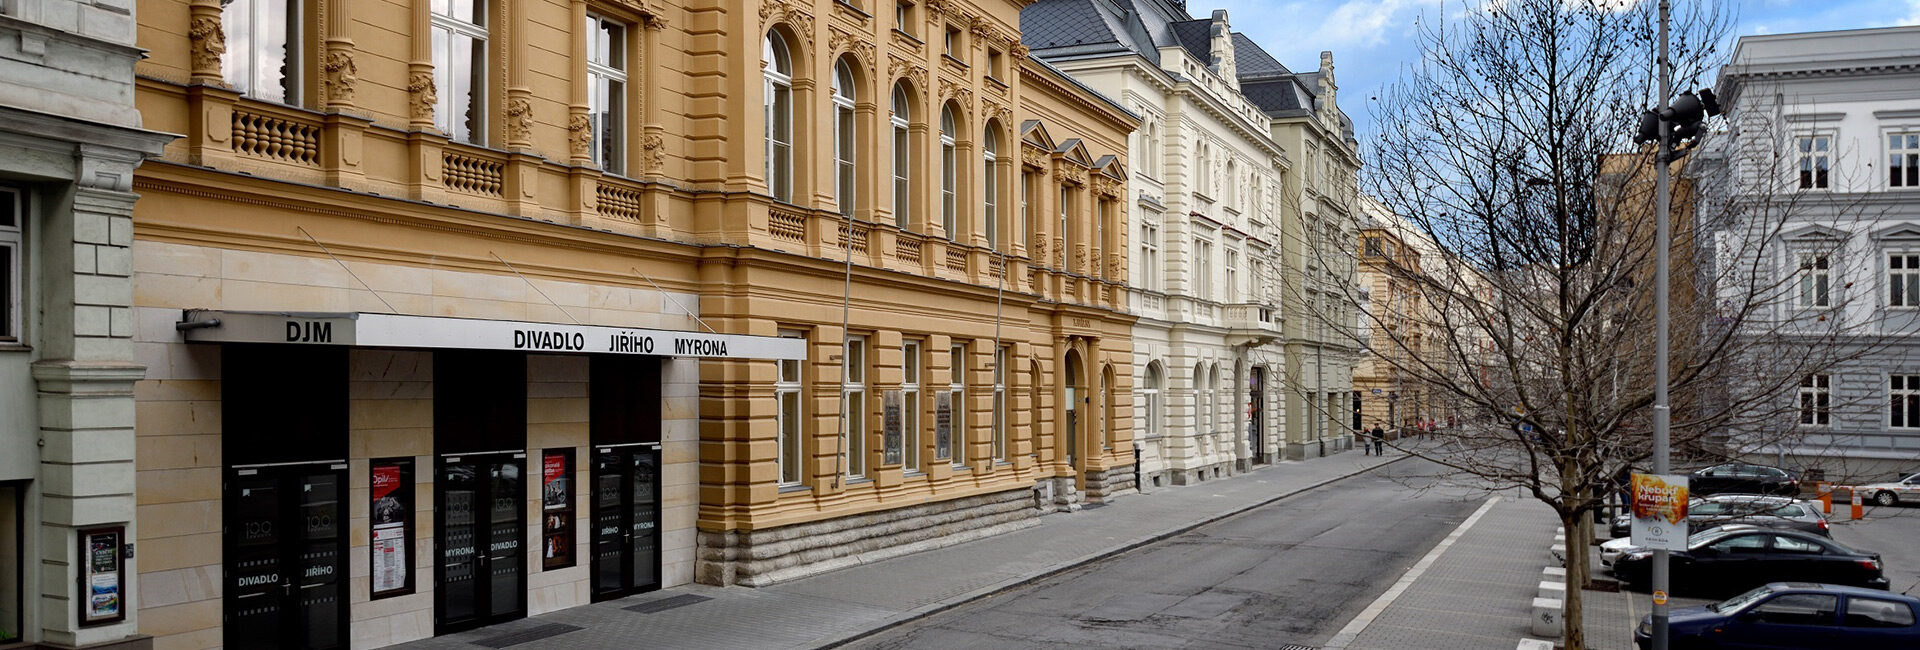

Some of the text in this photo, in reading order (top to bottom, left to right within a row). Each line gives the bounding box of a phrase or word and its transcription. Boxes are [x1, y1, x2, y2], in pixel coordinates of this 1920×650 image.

[286, 321, 332, 343] DJM
[514, 330, 728, 356] DIVADLO JIŘÍHO MYRONA
[445, 540, 518, 557] MYRONA DIVADLO
[239, 565, 333, 587] DIVADLO JIŘÍHO
